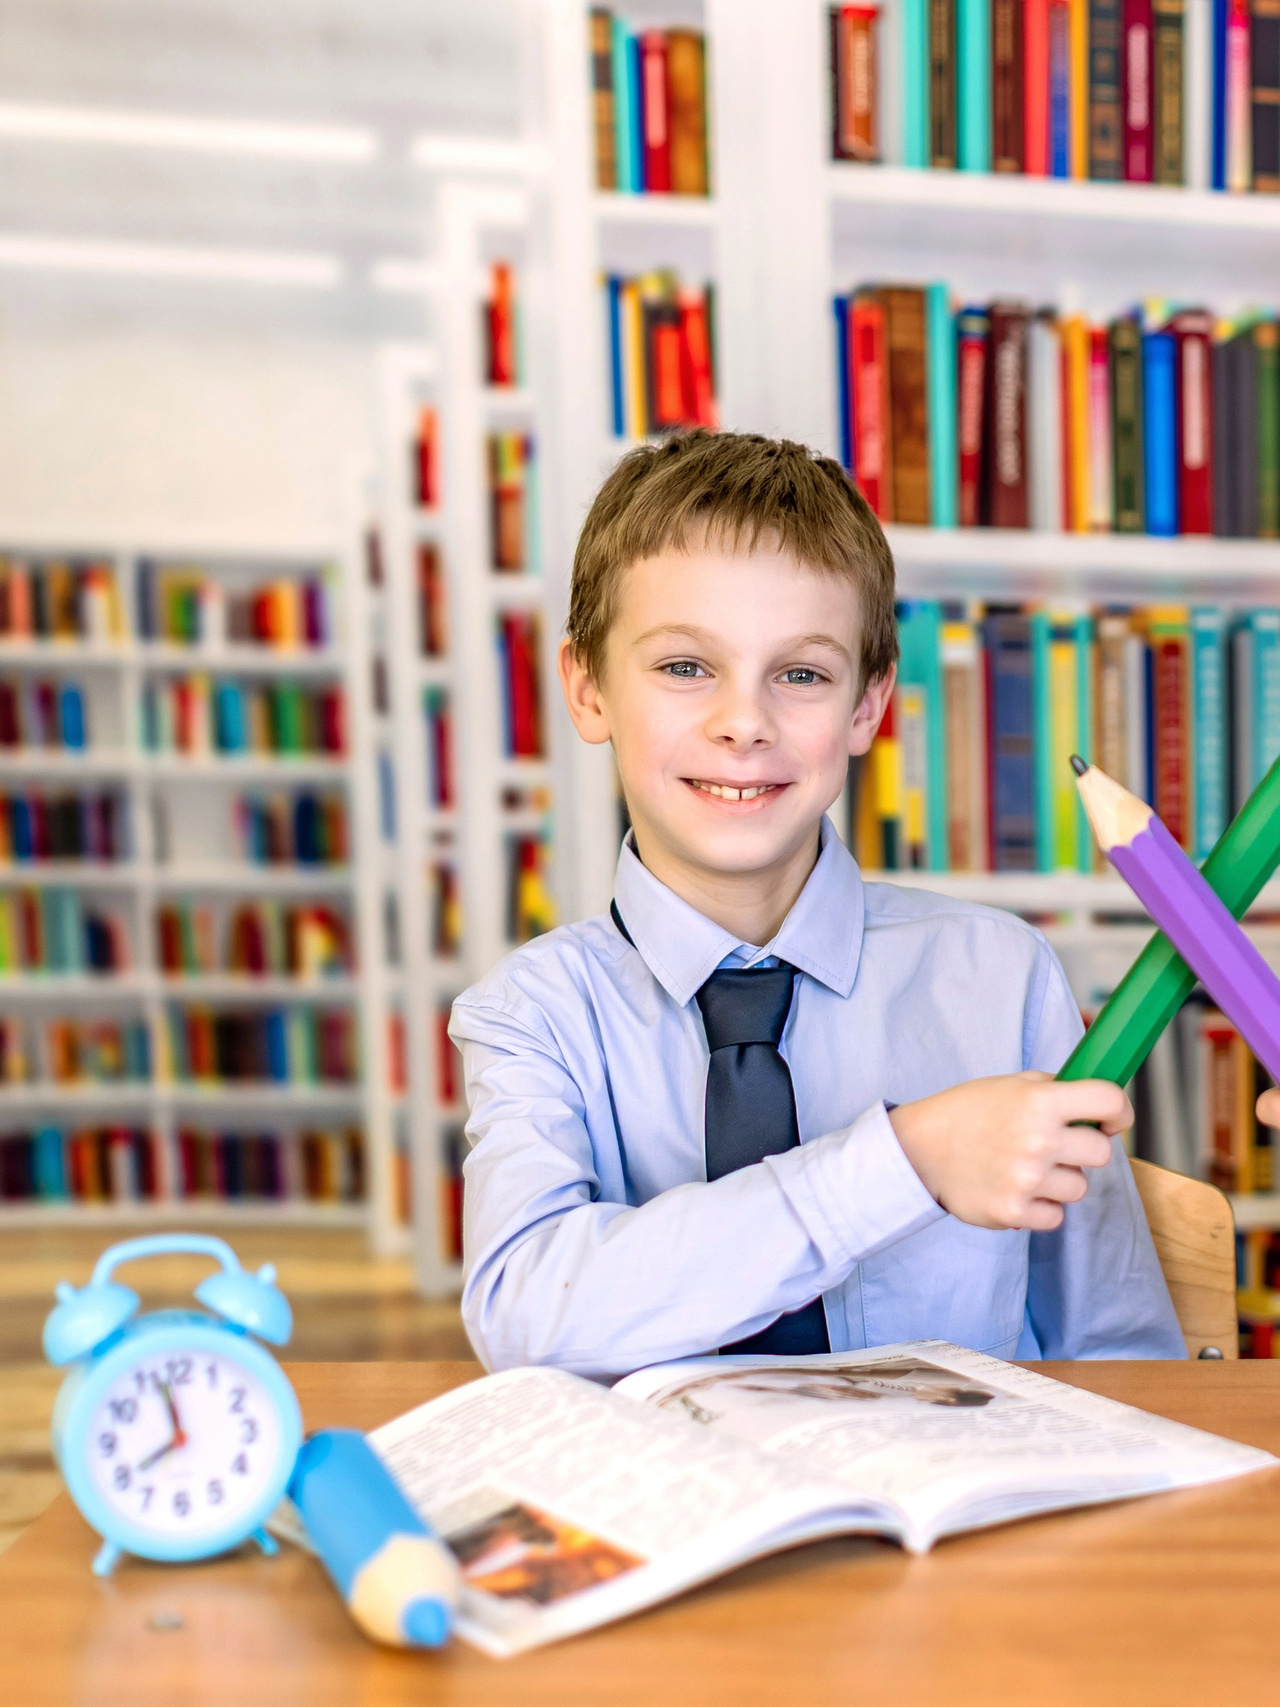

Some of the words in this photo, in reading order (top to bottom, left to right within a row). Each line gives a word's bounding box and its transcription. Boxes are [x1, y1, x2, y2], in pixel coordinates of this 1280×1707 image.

[135, 1370, 162, 1394] 11
[166, 1358, 193, 1385] 12
[207, 1363, 218, 1389] 1
[109, 1398, 138, 1424] 10
[230, 1387, 246, 1413] 2
[242, 1417, 258, 1444] 3
[100, 1432, 117, 1458] 9
[231, 1452, 248, 1475] 4
[115, 1464, 131, 1491] 8
[141, 1487, 155, 1512] 7
[173, 1490, 190, 1517] 6
[208, 1478, 224, 1505] 5
